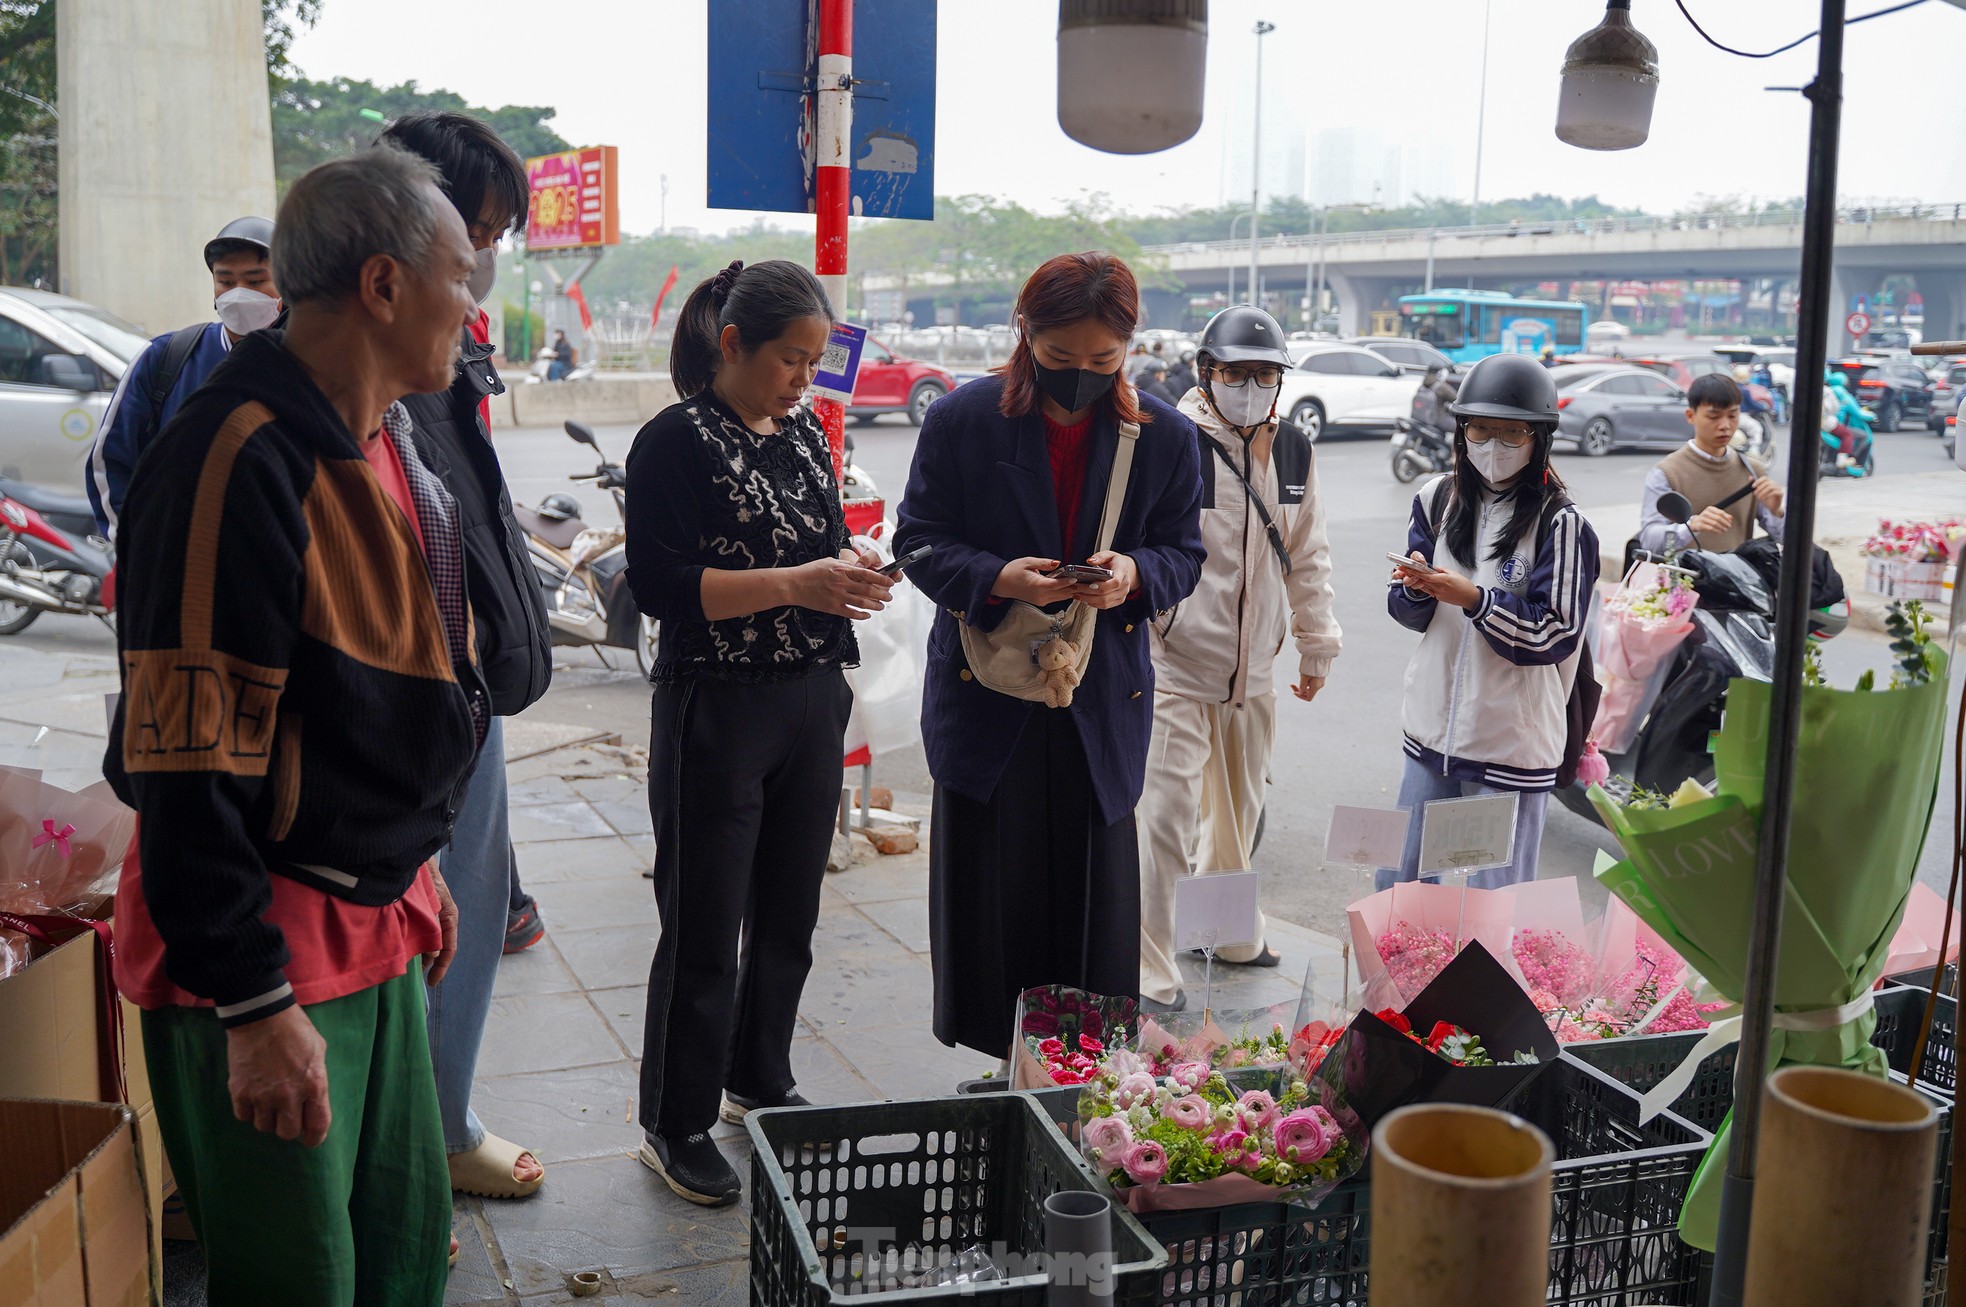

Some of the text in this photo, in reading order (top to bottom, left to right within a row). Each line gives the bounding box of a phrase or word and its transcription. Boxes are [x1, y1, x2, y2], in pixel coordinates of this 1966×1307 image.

[529, 185, 579, 227] 2025
[128, 662, 284, 758] ADE
[0, 913, 30, 932] ANEL
